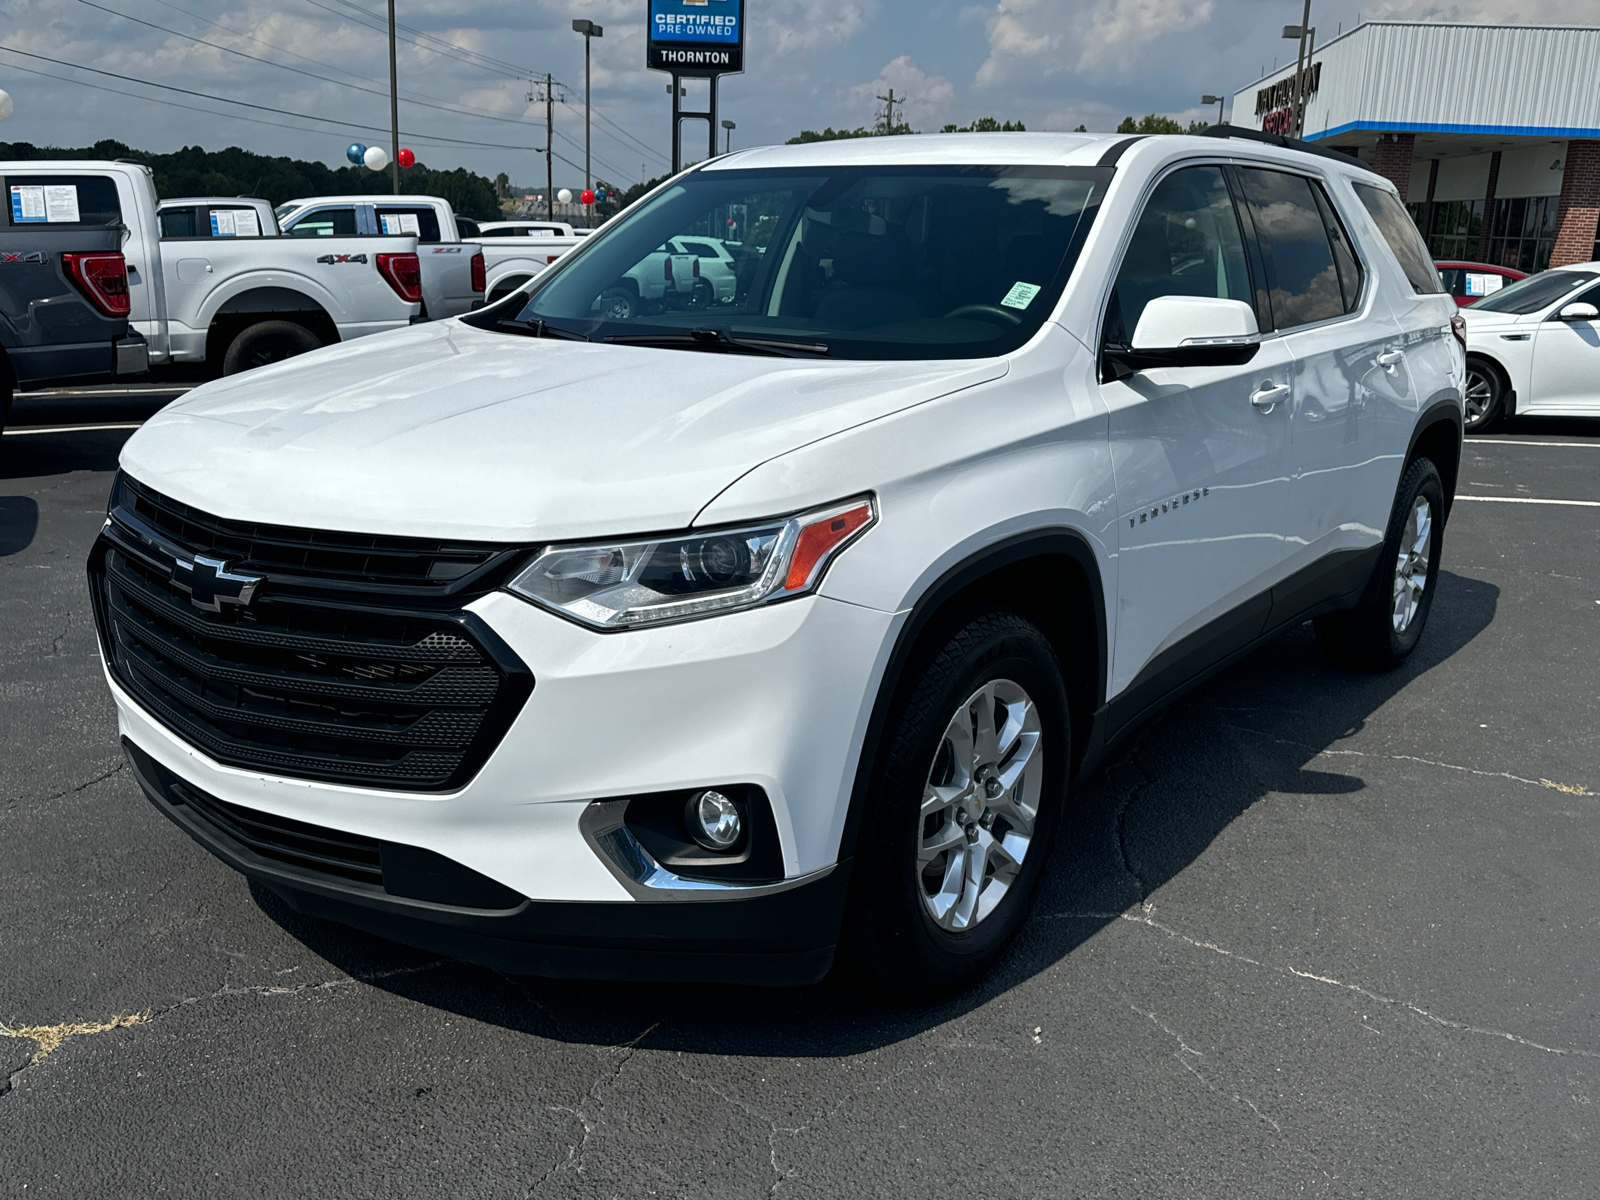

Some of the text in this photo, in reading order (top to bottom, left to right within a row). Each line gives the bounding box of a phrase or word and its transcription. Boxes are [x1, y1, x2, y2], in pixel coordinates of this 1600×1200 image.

[655, 14, 736, 26] CERTIFIED
[659, 24, 732, 35] PRE-OWNED
[661, 50, 729, 64] THORNTON
[0, 251, 48, 266] X4
[1129, 485, 1209, 528] TRAVERSE
